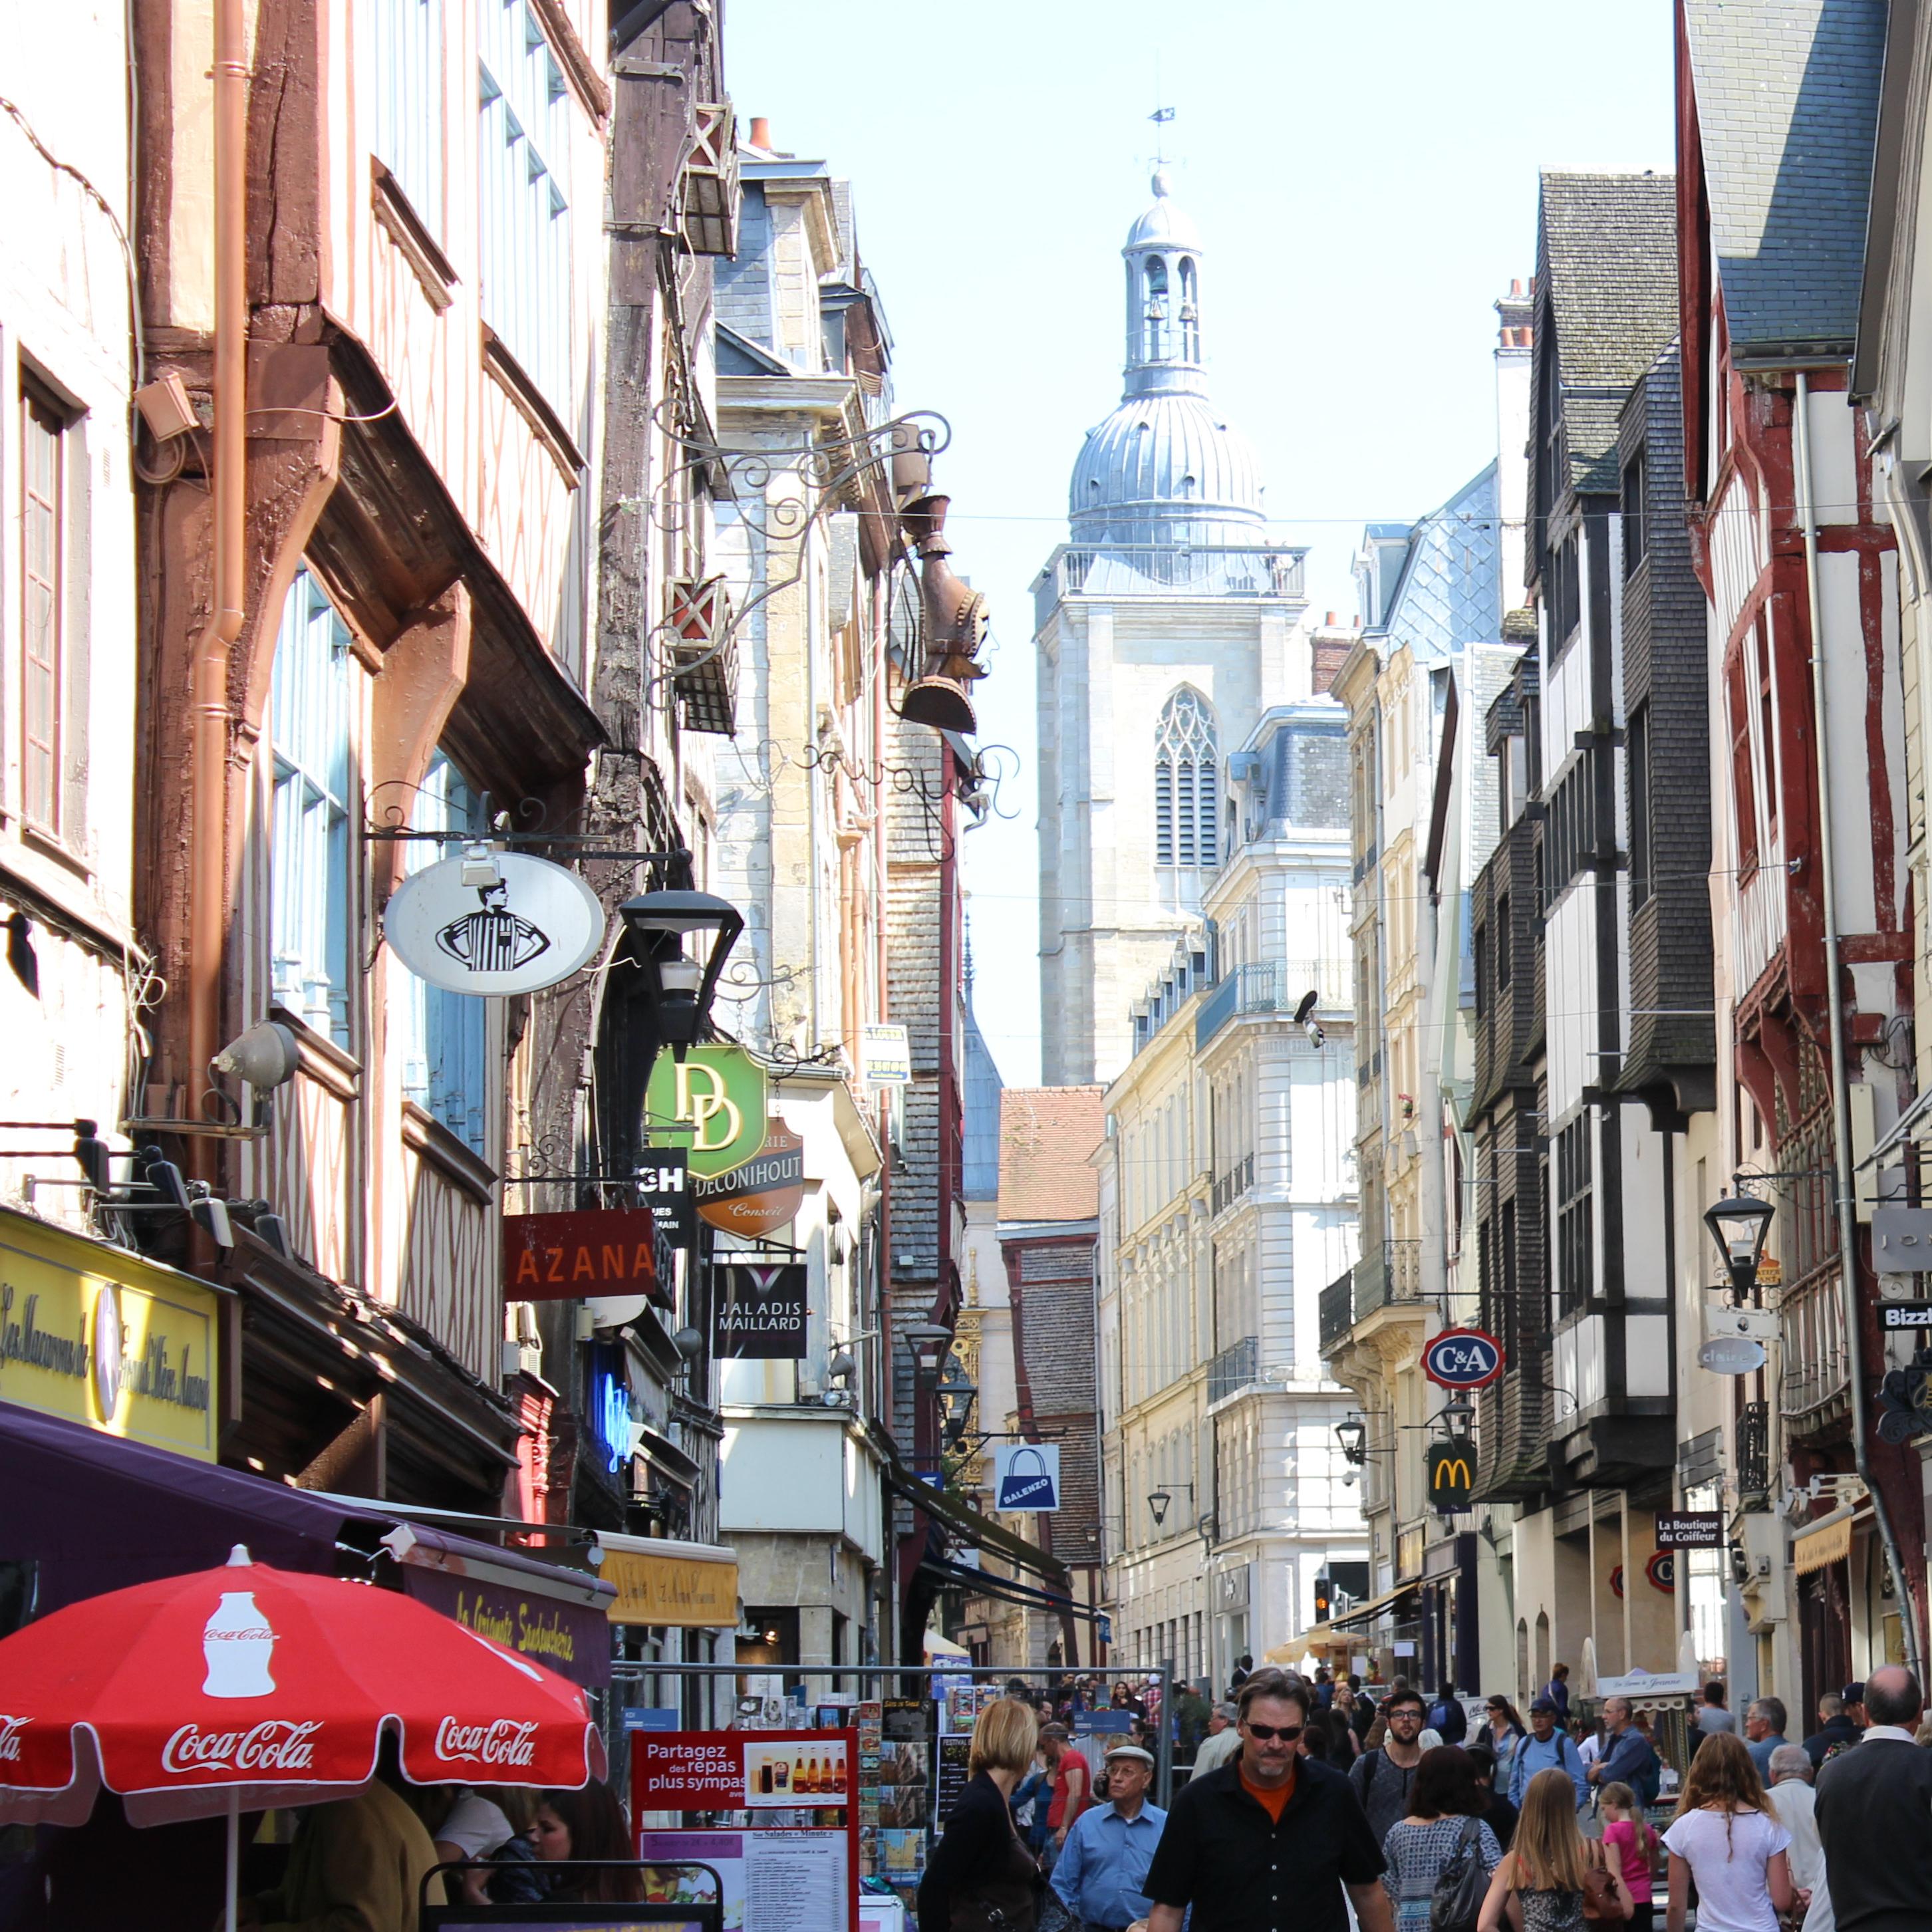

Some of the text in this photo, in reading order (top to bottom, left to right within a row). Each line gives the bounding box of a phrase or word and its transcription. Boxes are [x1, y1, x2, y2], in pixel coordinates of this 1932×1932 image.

[694, 1156, 801, 1198] DECONIHOUT
[728, 1202, 785, 1217] Conseil
[517, 1243, 656, 1284] AZANA
[719, 1302, 801, 1315] JALADIS
[719, 1317, 801, 1330] MAILLARD
[1436, 1345, 1490, 1373] C&A
[1003, 1478, 1049, 1505] BALENZO
[1659, 1520, 1719, 1533] La Boutique
[1659, 1532, 1717, 1542] du Coiffeur
[204, 1628, 274, 1641] Coca-Cola
[1646, 1677, 1681, 1690] Jeanne
[162, 1719, 325, 1773] Coca-Cola
[434, 1715, 539, 1766] Coca-Cola
[647, 1744, 727, 1760] Partagez
[669, 1760, 736, 1775] des repas
[648, 1774, 746, 1792] plus sympas
